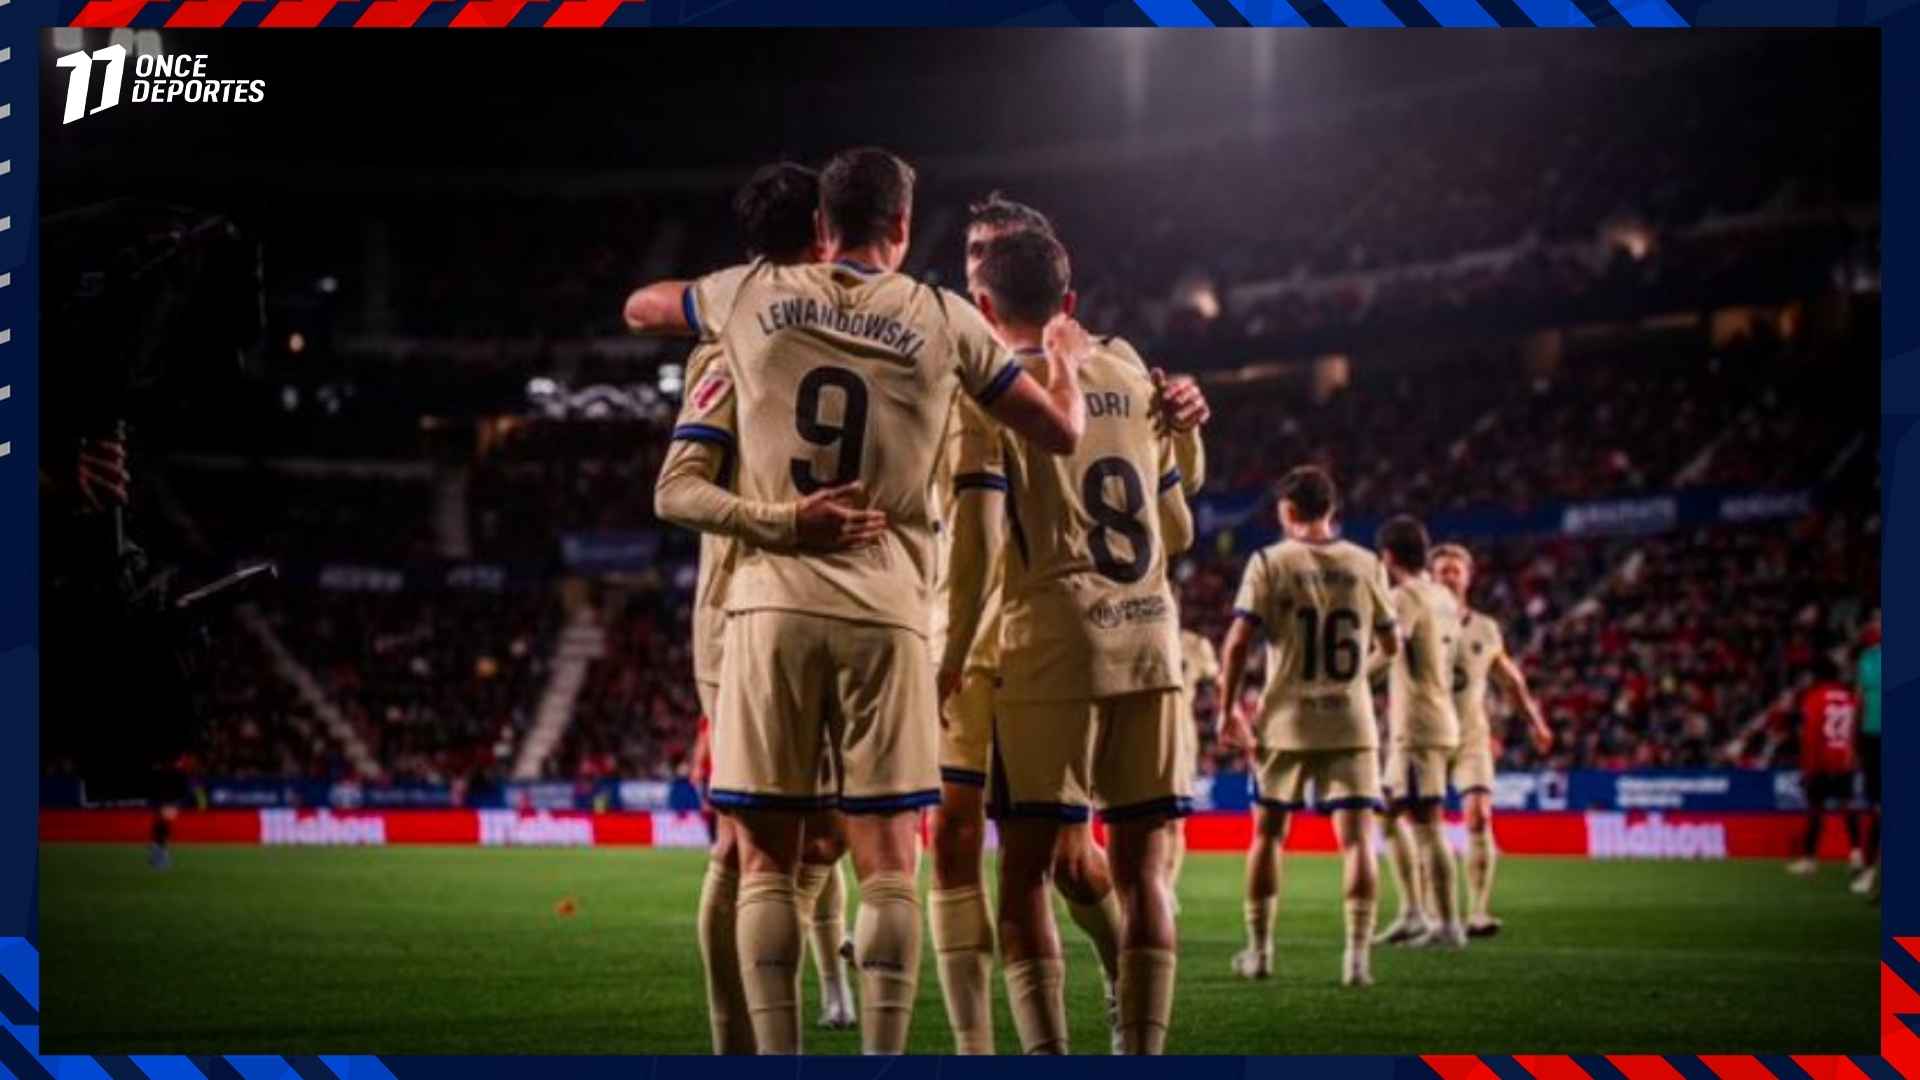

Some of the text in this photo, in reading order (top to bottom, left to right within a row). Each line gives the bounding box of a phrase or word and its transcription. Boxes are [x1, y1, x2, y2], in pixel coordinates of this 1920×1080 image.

[756, 298, 925, 358] LEWANDOWSKI
[790, 366, 868, 496] 9
[1085, 391, 1130, 418] DRI
[1082, 457, 1152, 584] 8
[1296, 607, 1361, 682] 16
